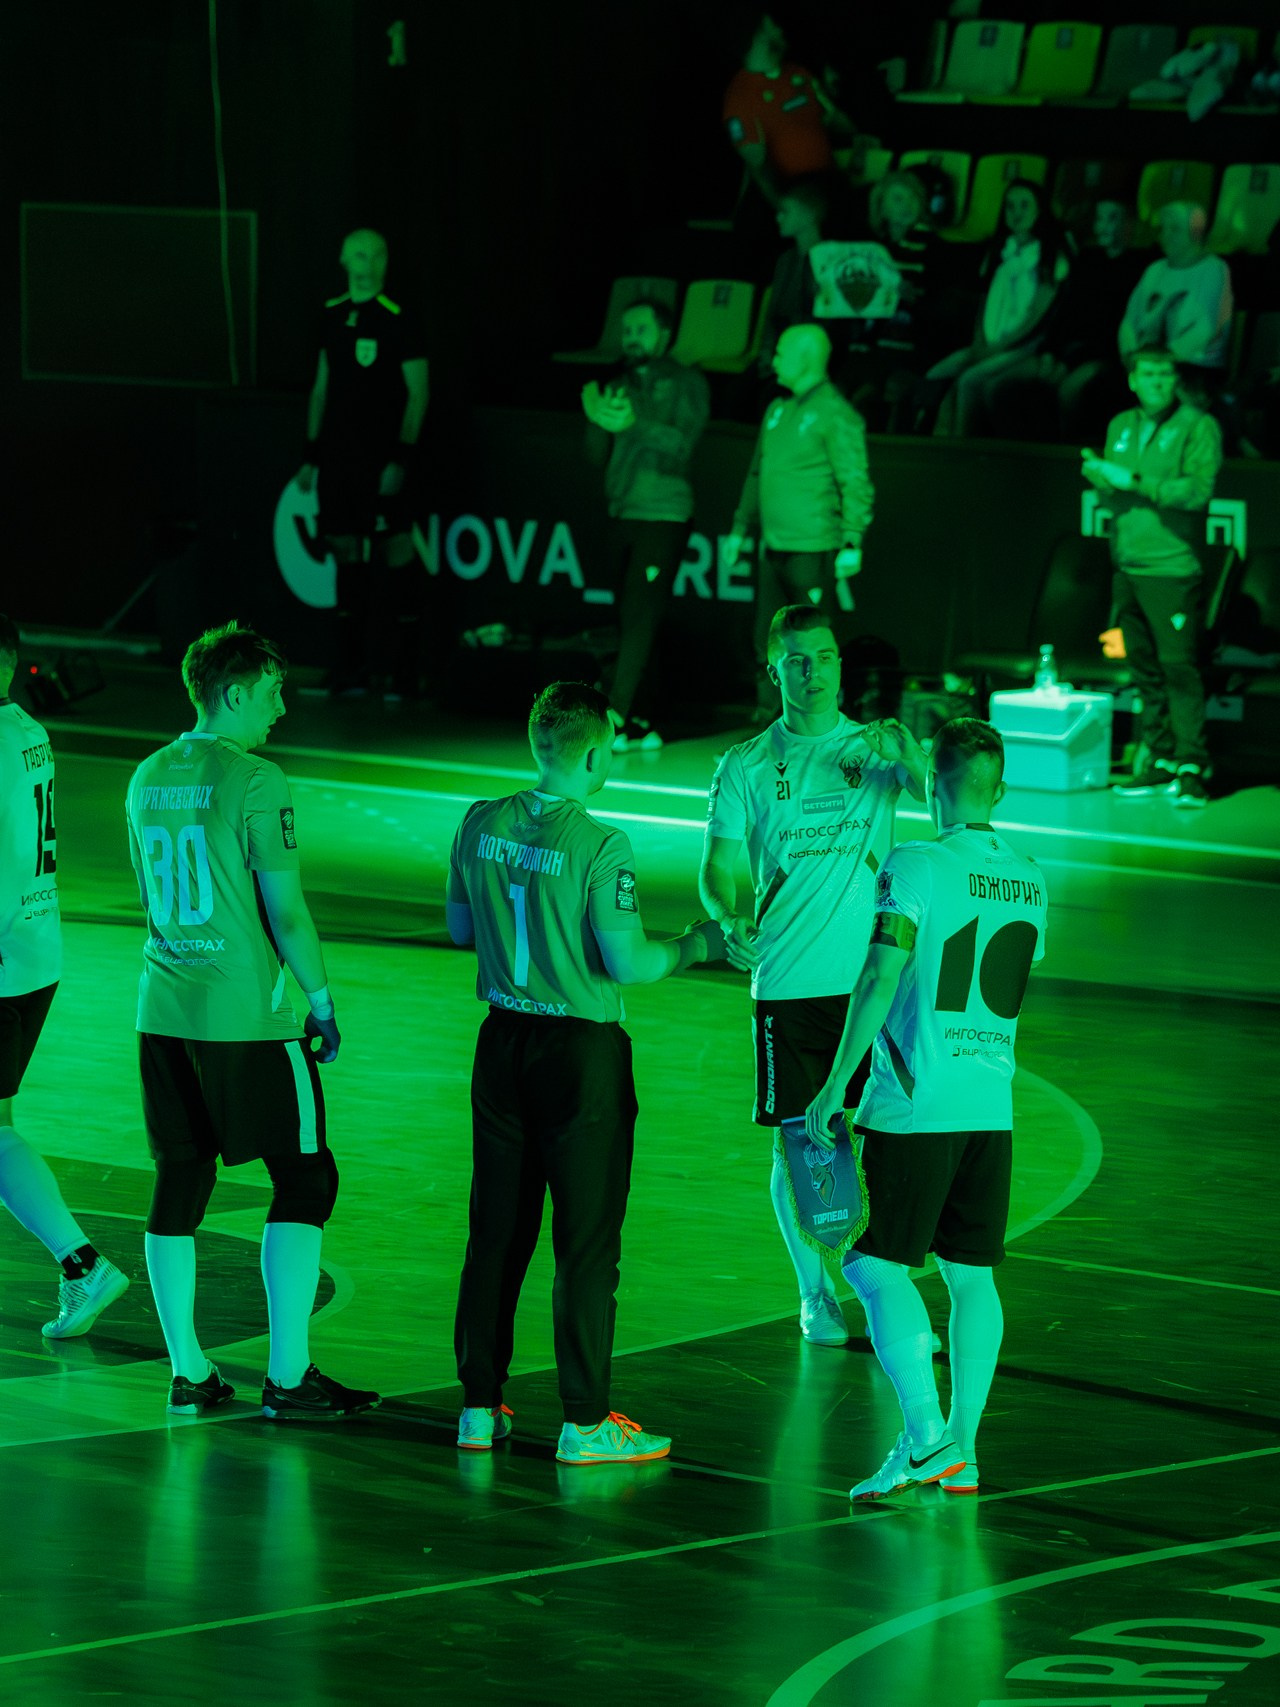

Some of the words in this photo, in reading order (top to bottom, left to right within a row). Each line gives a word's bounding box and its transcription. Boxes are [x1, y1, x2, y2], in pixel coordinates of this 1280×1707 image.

[776, 780, 791, 801] 21
[804, 800, 843, 810] БЕТСИТИ
[778, 817, 872, 843] ИНГОССТРАХ
[476, 833, 565, 877] КОСТРОМИН
[787, 846, 842, 861] NORMAN
[143, 824, 214, 926] 30
[969, 872, 1042, 907] ОБЖОРИН
[509, 883, 530, 987] 1
[934, 914, 1038, 1019] 10
[812, 1208, 849, 1226] ТОРПЕДО
